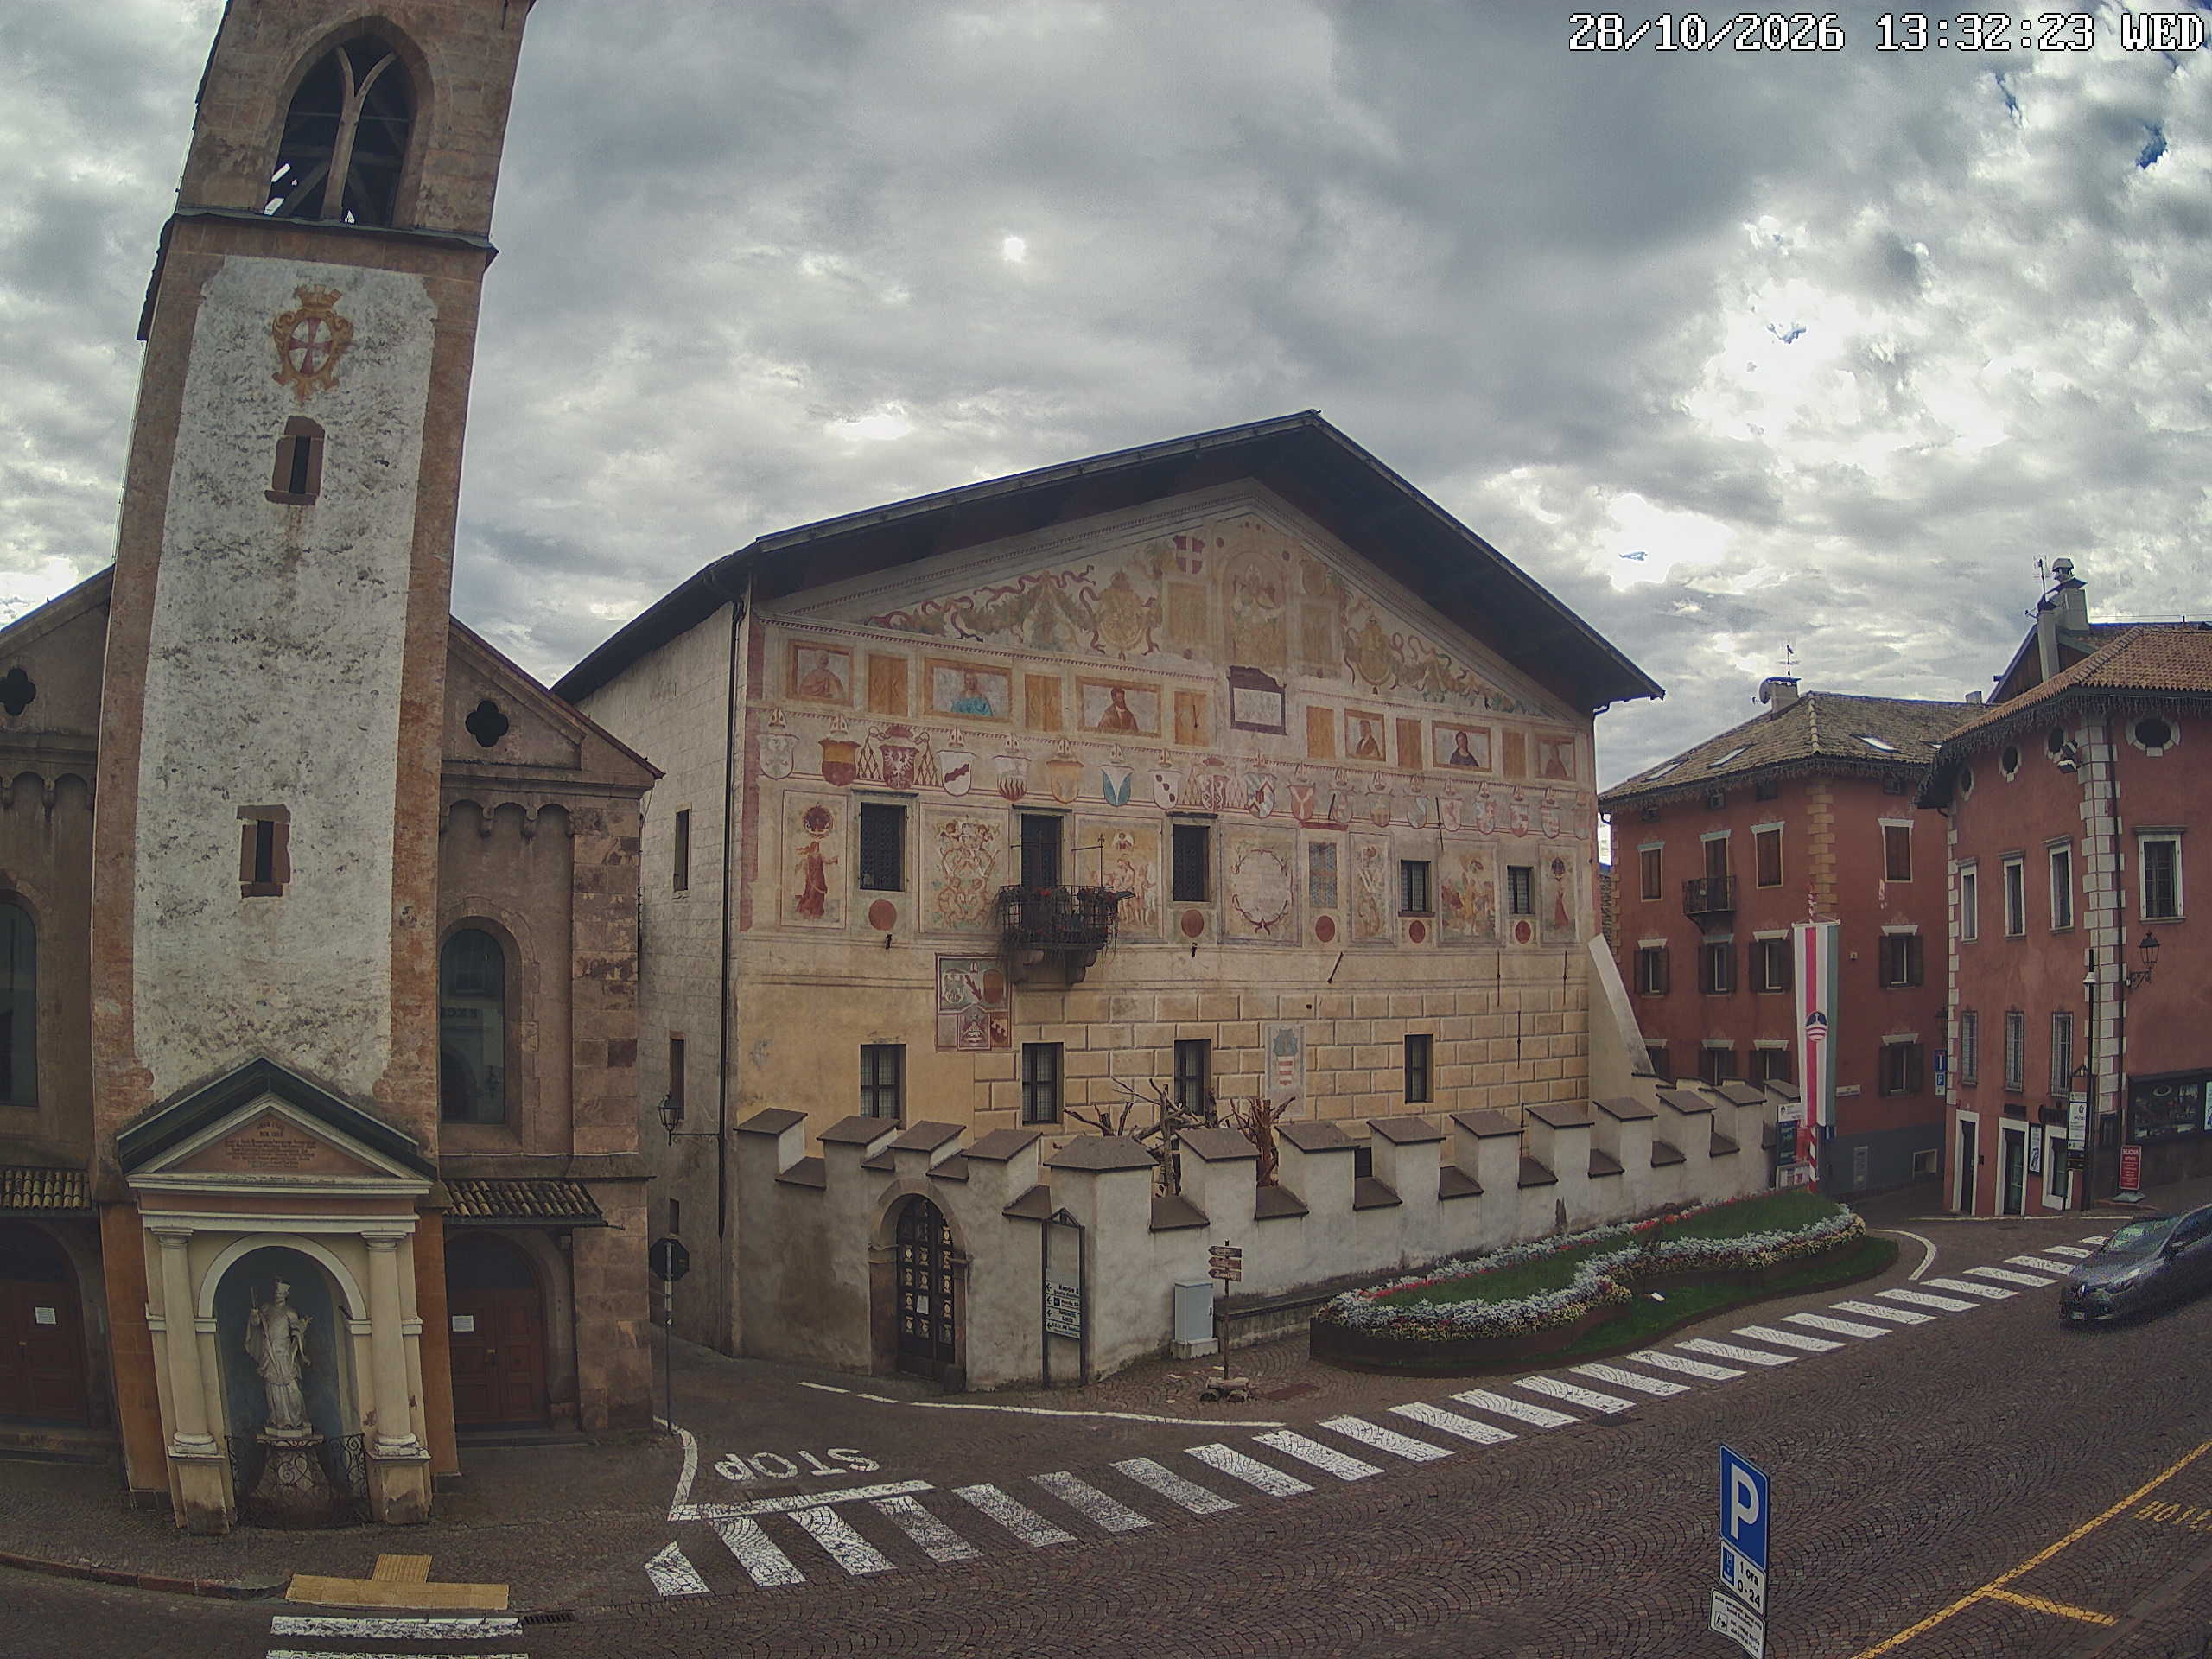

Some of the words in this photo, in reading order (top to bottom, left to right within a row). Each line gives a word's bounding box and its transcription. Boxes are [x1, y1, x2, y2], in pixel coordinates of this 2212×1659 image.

[714, 1448, 880, 1481] STOP
[1730, 1462, 1760, 1541] P
[1745, 1567, 1759, 1587] ora
